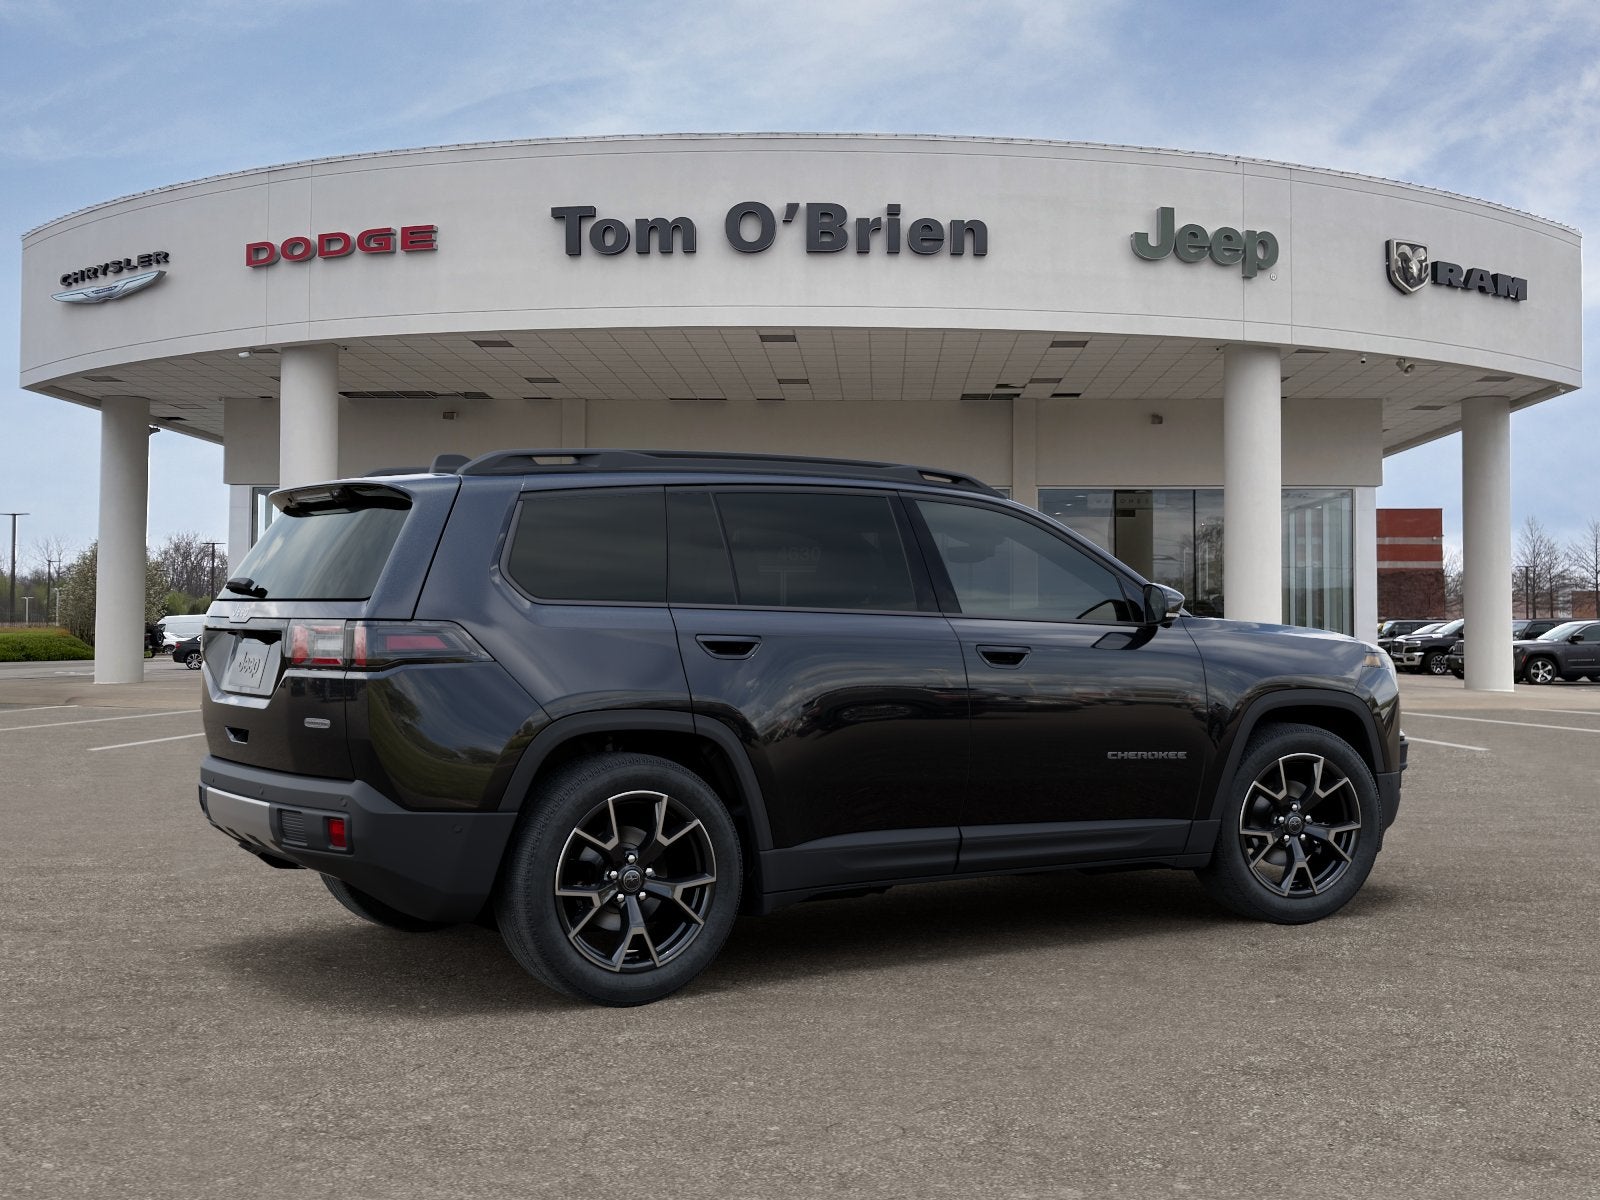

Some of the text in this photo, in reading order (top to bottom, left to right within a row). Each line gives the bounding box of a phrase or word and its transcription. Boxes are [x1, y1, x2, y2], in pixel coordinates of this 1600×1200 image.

[246, 225, 438, 269] DODGE
[551, 201, 989, 256] Tom O'Brien
[1131, 206, 1279, 279] Jeep
[60, 251, 170, 287] CHRYSLER
[1431, 260, 1528, 302] RAM
[239, 651, 261, 679] Jeep
[1107, 751, 1187, 760] CHEROKEE
